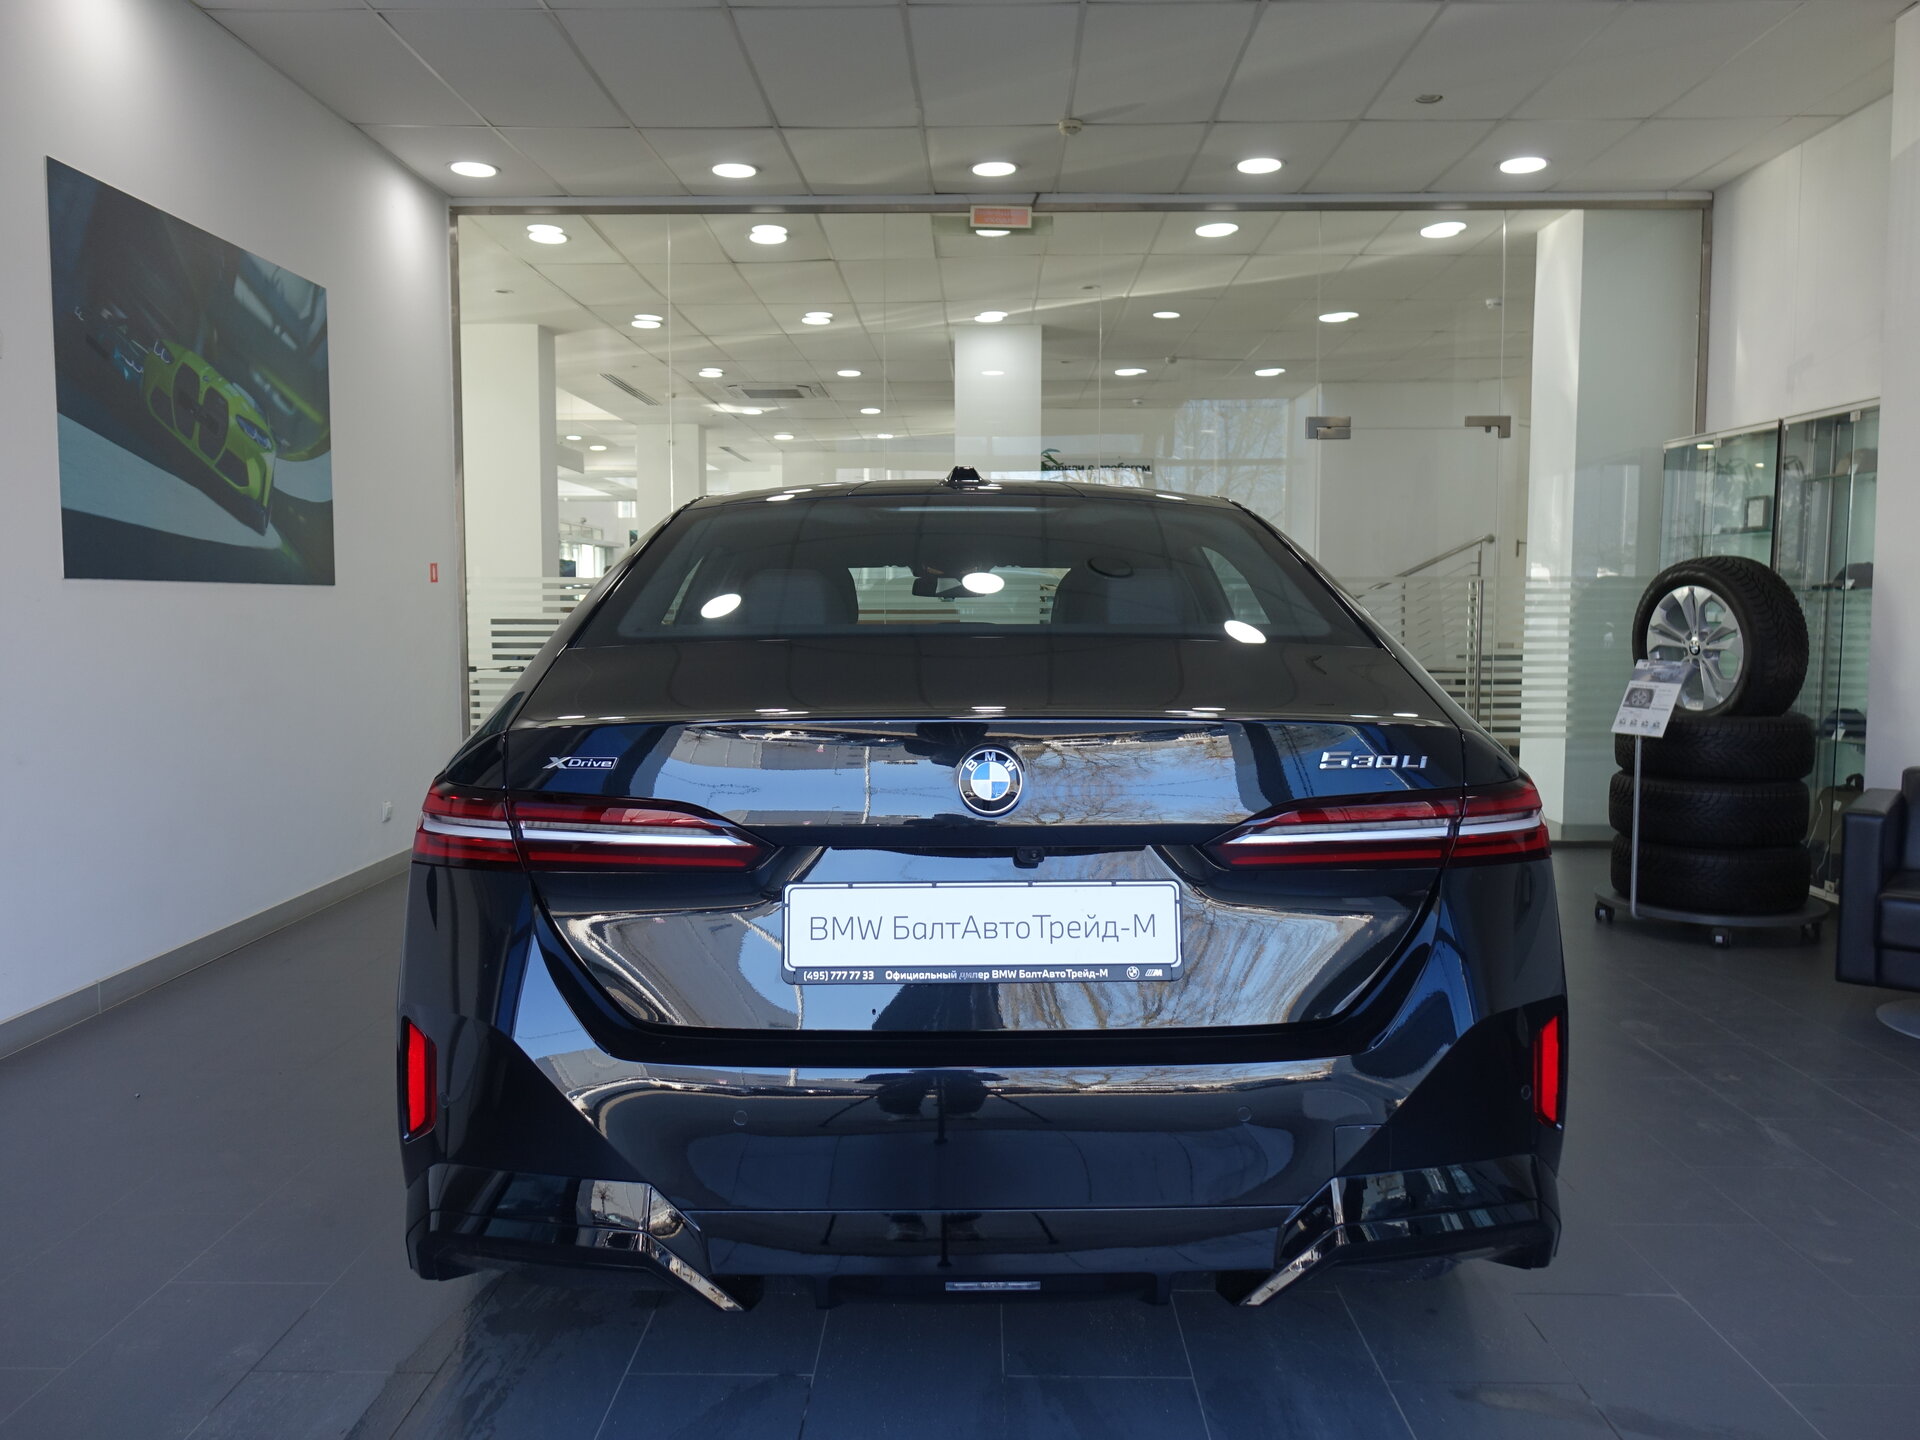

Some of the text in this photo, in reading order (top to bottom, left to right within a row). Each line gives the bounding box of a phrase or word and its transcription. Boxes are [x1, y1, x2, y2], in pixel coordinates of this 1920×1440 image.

[965, 751, 1016, 772] BMW
[809, 913, 1157, 944] BMW БалтАвтоТрейд-М
[803, 970, 828, 981] (495)
[830, 970, 848, 980] 777
[849, 970, 860, 980] 77
[862, 970, 874, 980] 33
[885, 969, 957, 981] Официальный
[991, 969, 1017, 979] BMW
[1019, 968, 1108, 980] БалтАвтоТрейд-М
